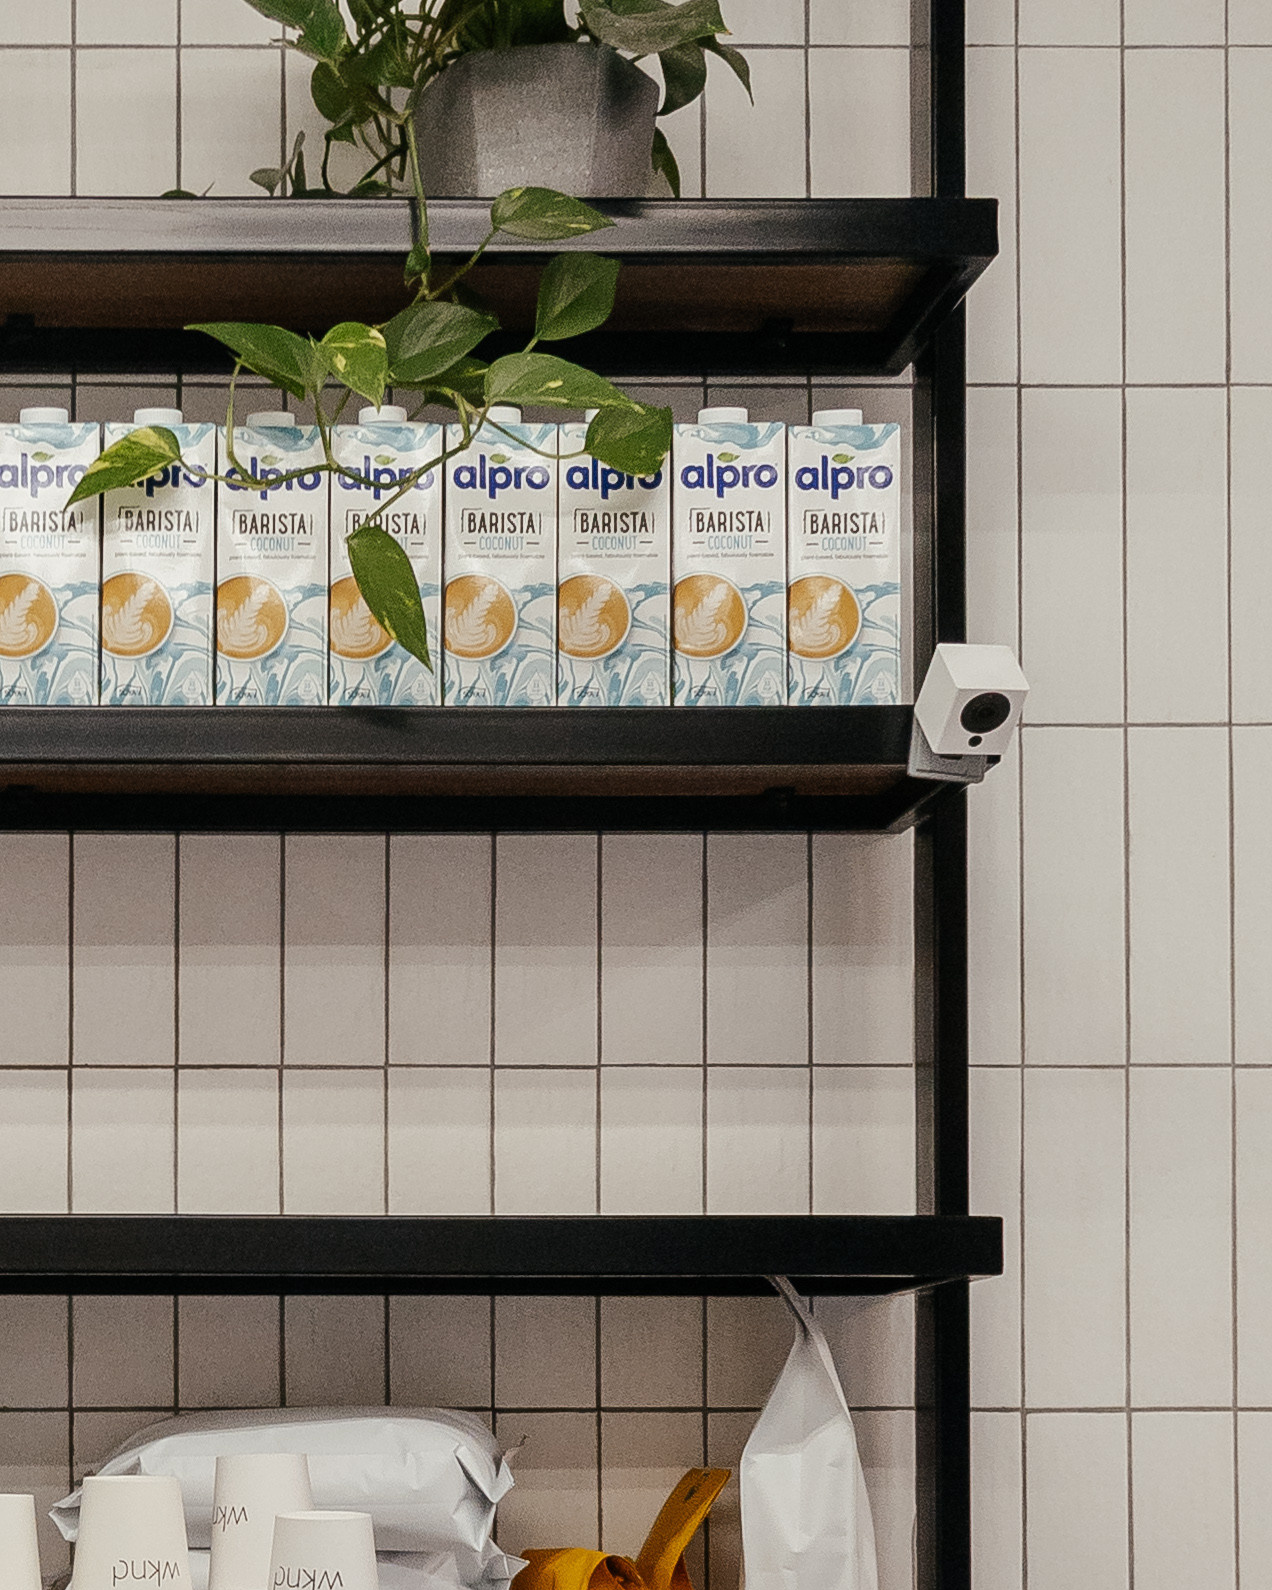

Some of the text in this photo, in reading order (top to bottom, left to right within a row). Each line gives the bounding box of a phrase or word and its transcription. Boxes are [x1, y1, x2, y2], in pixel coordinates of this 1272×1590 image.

[453, 455, 550, 499] alpro
[681, 454, 778, 498] alpro
[795, 456, 893, 499] alpro
[9, 511, 77, 532] BARISTA
[125, 510, 192, 532] BARISTA
[239, 513, 307, 534] BARISTA
[468, 512, 535, 533] BARISTA
[580, 512, 648, 533] BARISTA
[696, 511, 764, 532] BARISTA
[810, 513, 878, 534] BARISTA
[21, 535, 65, 549] COCONUT
[136, 534, 180, 548] COCONUT
[251, 537, 295, 550] COCONUT
[479, 537, 524, 550] COCONUT
[592, 536, 637, 550] COCONUT
[708, 536, 753, 549] COCONUT
[822, 537, 867, 550] COCONUT
[113, 1559, 181, 1588] wknd
